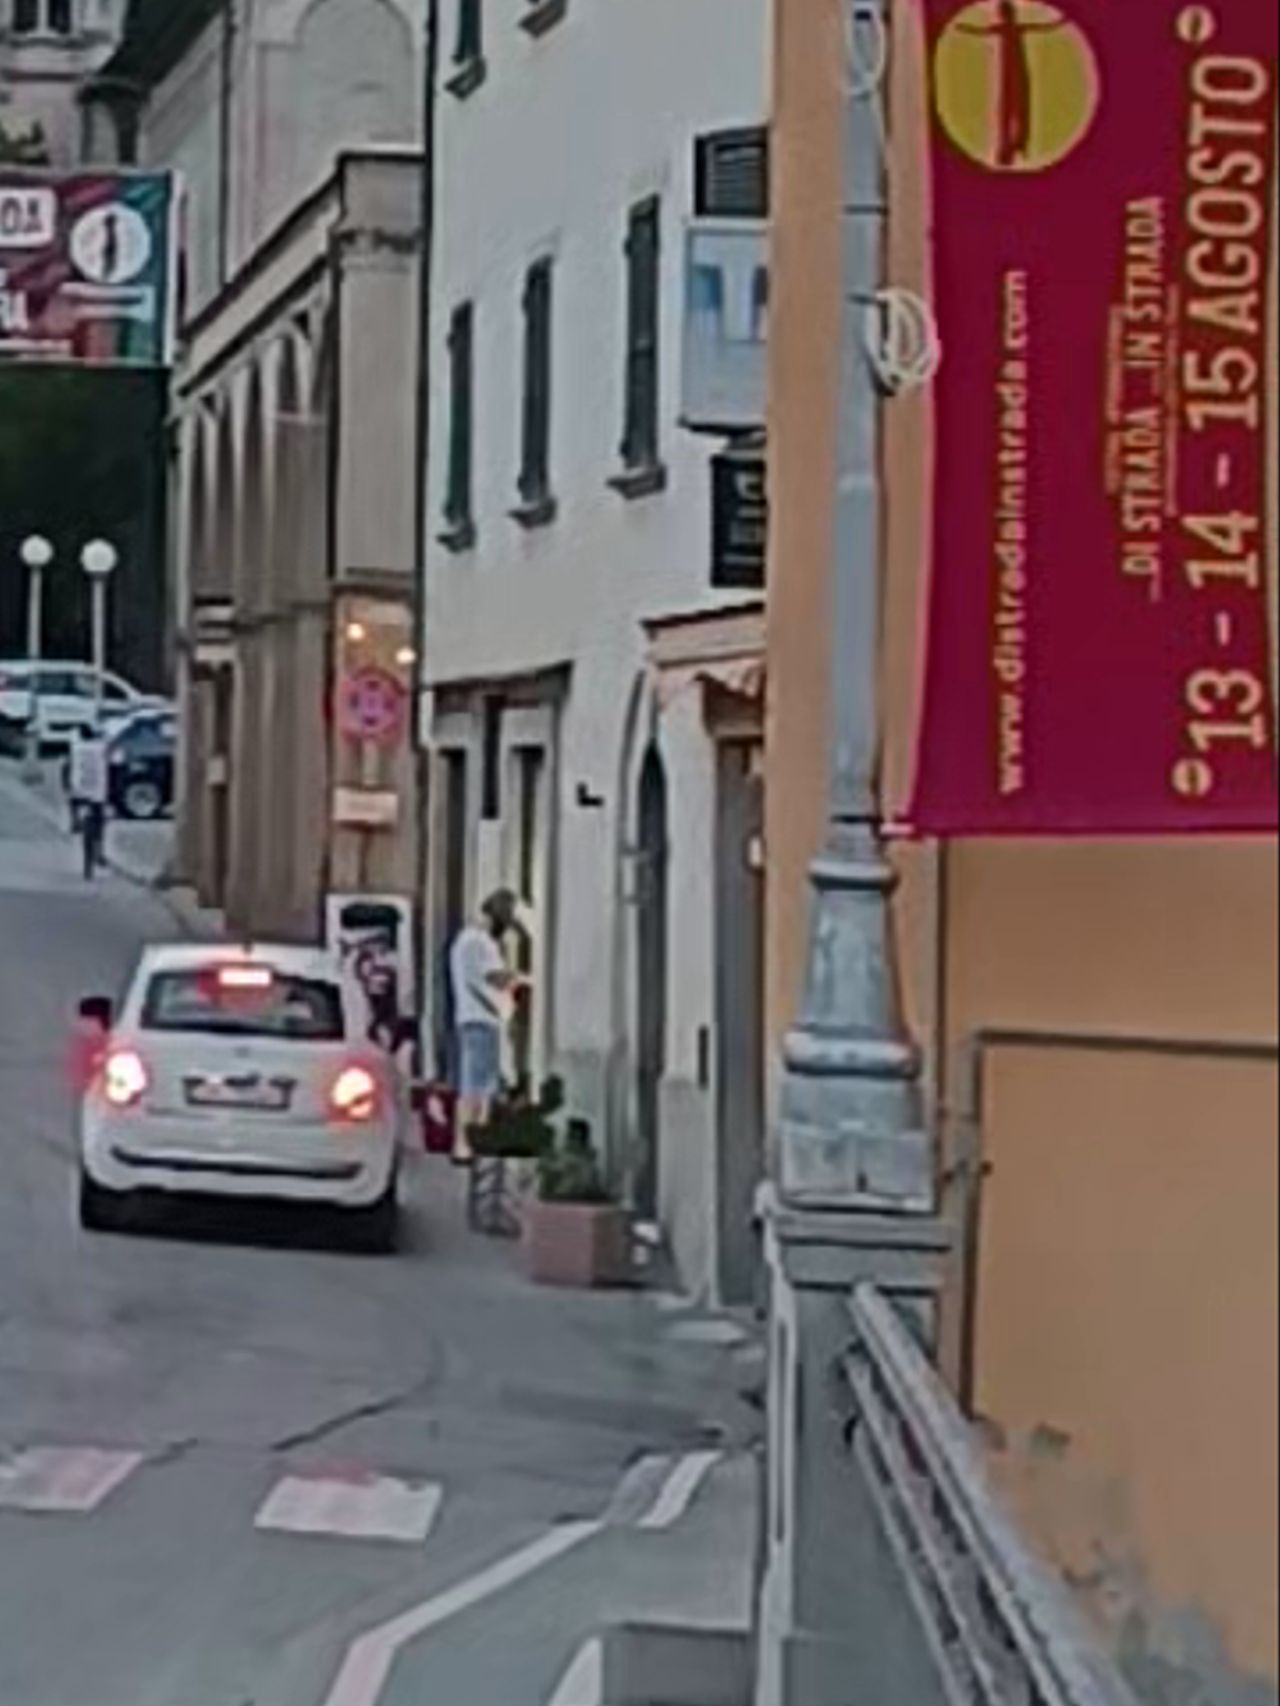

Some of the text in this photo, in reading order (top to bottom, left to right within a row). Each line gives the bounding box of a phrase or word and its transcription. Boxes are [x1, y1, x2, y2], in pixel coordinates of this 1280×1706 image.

[1184, 55, 1268, 335] AGOSTO
[1122, 195, 1165, 322] STRADA
[1182, 346, 1259, 432] 15
[993, 268, 1029, 794] www.distradainstrada.com
[1121, 406, 1162, 532] STRADA
[1181, 509, 1260, 590] 14
[1184, 668, 1266, 751] 13
